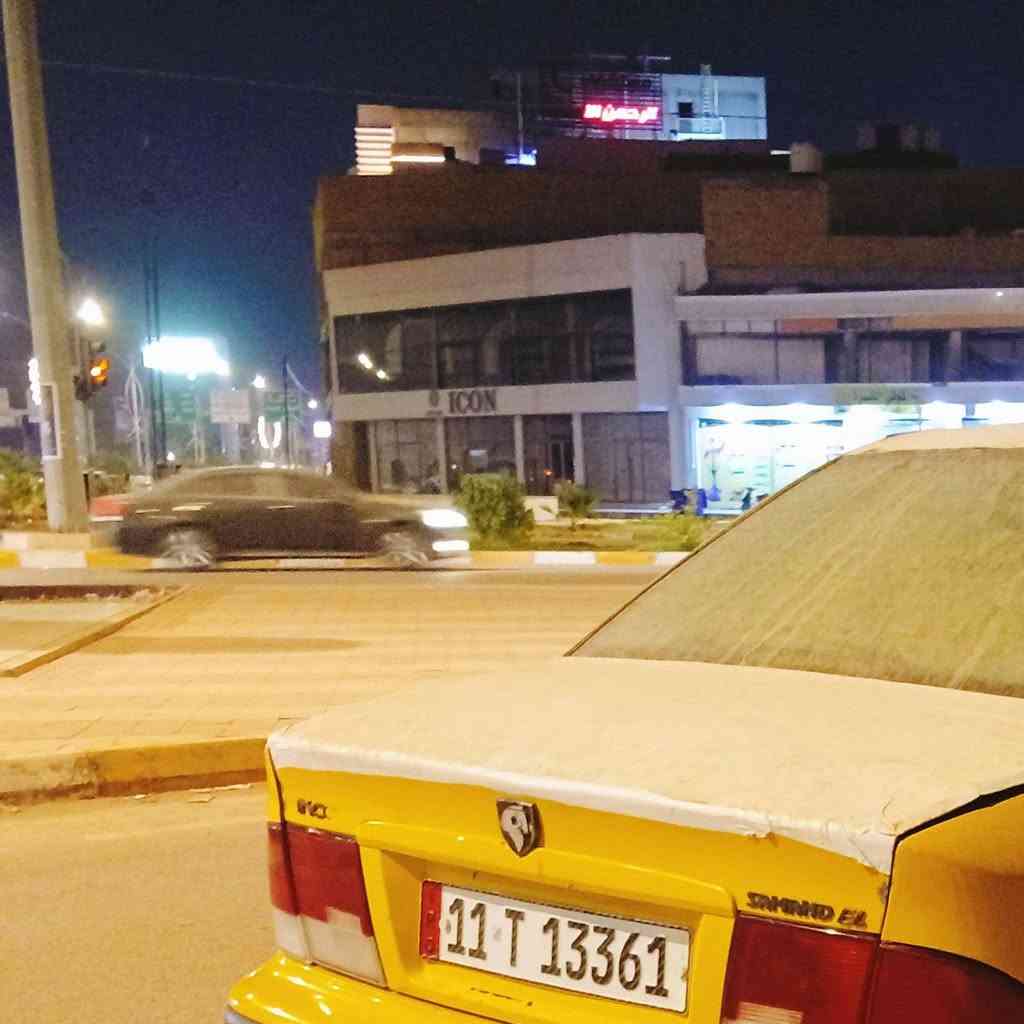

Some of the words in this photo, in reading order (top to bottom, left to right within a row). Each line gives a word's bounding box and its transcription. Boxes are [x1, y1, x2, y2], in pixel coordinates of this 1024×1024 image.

[448, 389, 497, 414] ICON
[747, 891, 835, 922] SAMAND
[447, 897, 487, 960] 11
[505, 908, 524, 967] T
[540, 917, 669, 997] 13361
